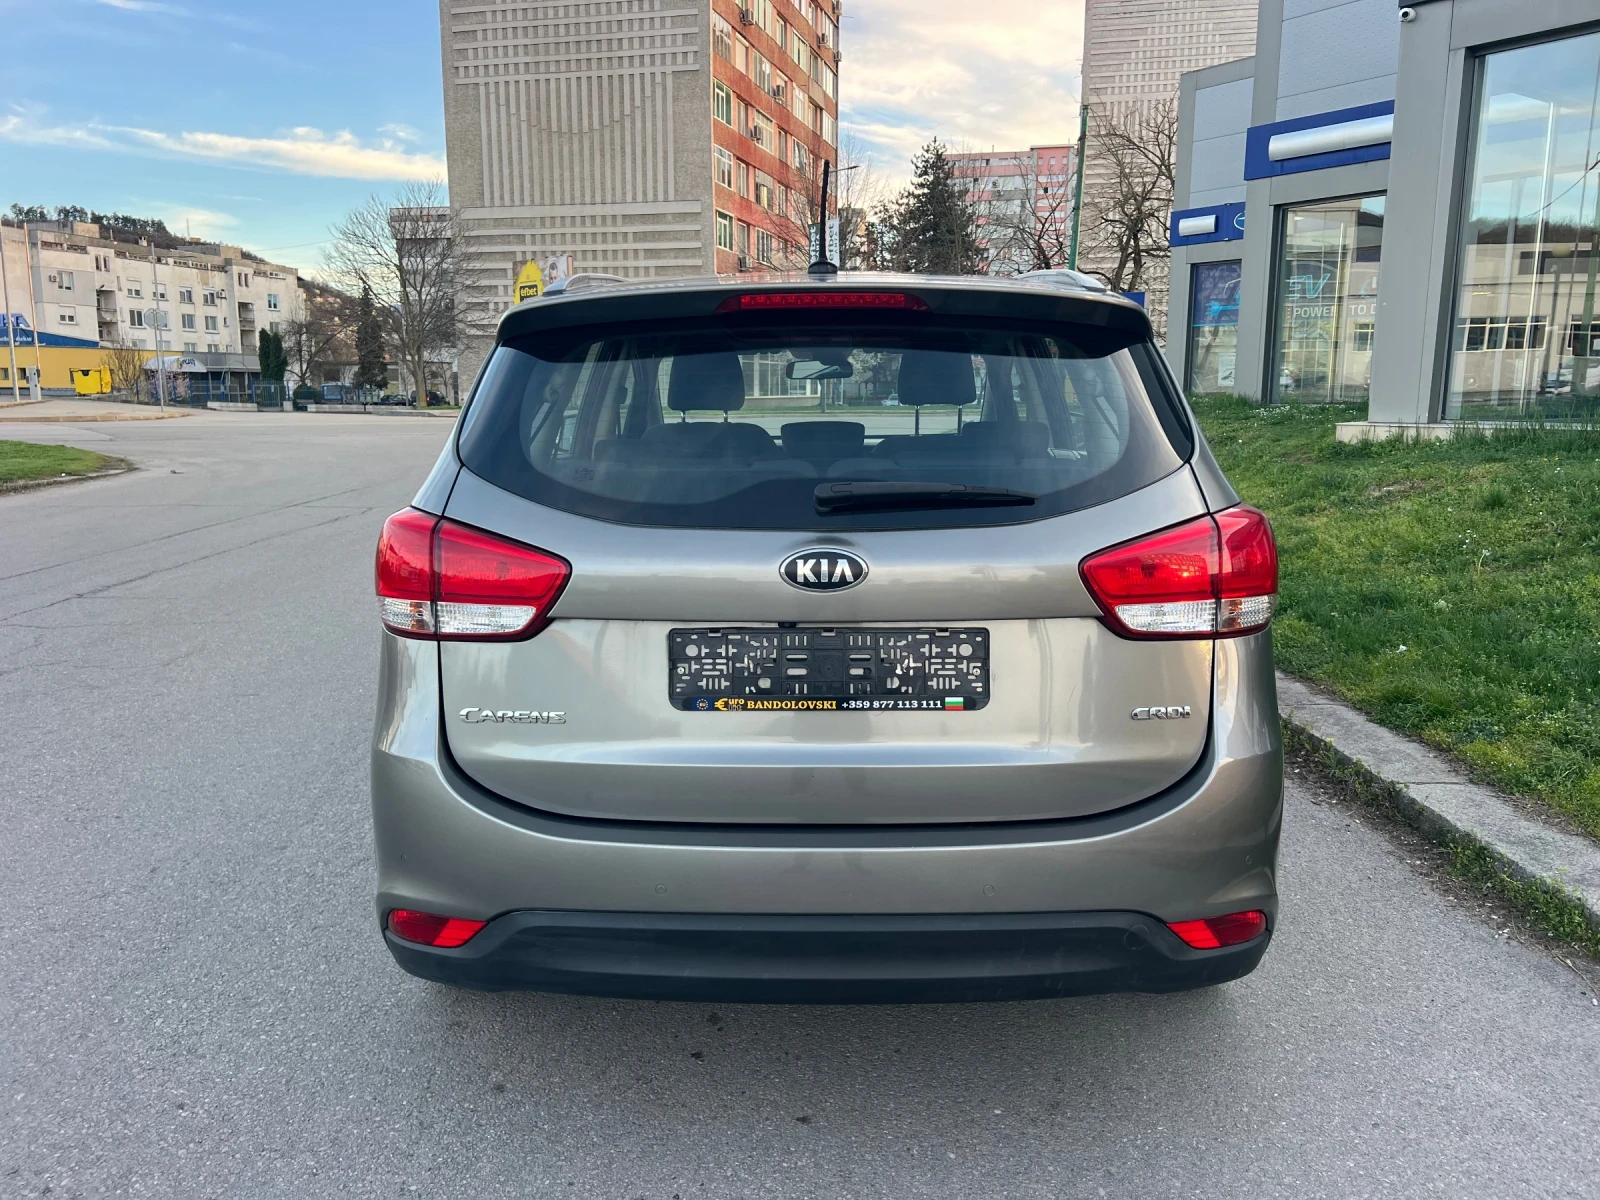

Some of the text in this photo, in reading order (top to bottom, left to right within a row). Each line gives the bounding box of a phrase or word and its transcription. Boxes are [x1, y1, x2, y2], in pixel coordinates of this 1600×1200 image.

[520, 287, 537, 297] efbet
[1349, 305, 1367, 315] TO
[796, 559, 854, 582] KIA
[747, 701, 836, 709] BANDOLOVSKI
